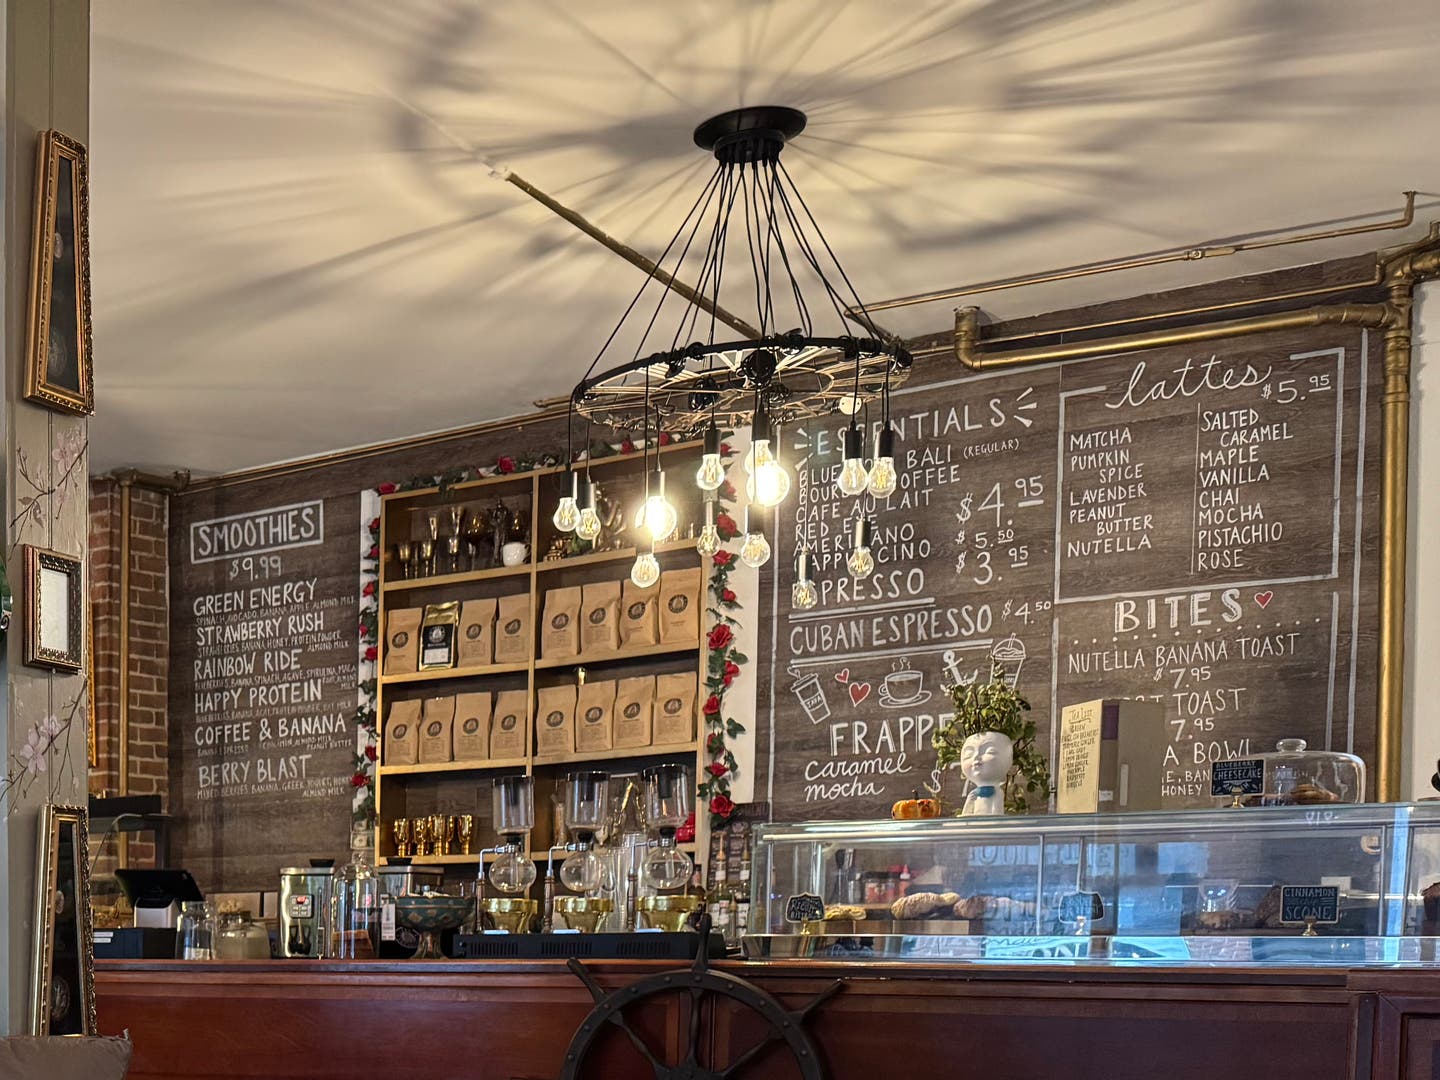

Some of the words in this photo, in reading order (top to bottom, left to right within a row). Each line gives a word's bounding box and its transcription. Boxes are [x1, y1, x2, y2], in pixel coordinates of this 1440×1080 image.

[1105, 355, 1272, 408] lattes
[1200, 408, 1259, 432] SALTED
[1070, 427, 1132, 451] MATCHA
[1220, 422, 1293, 448] CARAMEL
[906, 446, 951, 470] BALI
[963, 438, 1021, 460] (REGULAR)
[1071, 449, 1130, 471] PUMPKIN
[1199, 445, 1259, 469] MAPLE
[901, 464, 961, 490] OFFEE
[1099, 463, 1145, 483] SPICE
[1199, 464, 1270, 488] VANILLA
[796, 500, 840, 524] CAFE
[851, 499, 877, 517] AU
[886, 488, 934, 512] LAIT
[1070, 482, 1147, 507] LAVENDER
[1199, 487, 1240, 509] CHAI
[1069, 502, 1127, 524] PEANUT
[1096, 514, 1154, 536] BUTTER
[1198, 503, 1264, 527] MOCHA
[198, 507, 315, 556] SMOOTHIES
[793, 523, 915, 557] AMERIANO
[795, 521, 829, 542] RED
[843, 513, 879, 534] EE
[1198, 522, 1283, 549] PISTACHIO
[1067, 534, 1152, 558] NUTELLA
[229, 555, 282, 582] $9.99
[1198, 549, 1244, 571] ROSE
[193, 589, 244, 617] GREEN
[250, 577, 317, 609] ENERGY
[1001, 599, 1052, 625] $4.50
[1114, 588, 1243, 633] BITES
[196, 616, 282, 647] STRAWBERRY
[288, 610, 324, 636] RUSH
[790, 620, 864, 655] CUBAN
[872, 604, 993, 647] ESPRESSO
[333, 640, 350, 649] MILK
[1068, 648, 1145, 674] NUTELLA
[1155, 641, 1229, 668] BANANA
[1236, 633, 1301, 659] TOAST
[194, 651, 256, 682] RAINBOW
[264, 649, 303, 673] RIDE
[1153, 665, 1211, 690] $7.95
[195, 687, 242, 714] HAPPY
[249, 678, 322, 708] PROTEIN
[1172, 688, 1247, 716] TOAST
[194, 721, 253, 746] COFFEE
[259, 718, 272, 742] &
[278, 712, 347, 738] BANANA
[1170, 717, 1215, 742] 7.95
[198, 760, 250, 789] BERRY
[257, 754, 312, 783] BLAST
[805, 752, 913, 781] caramel
[1213, 768, 1262, 781] CHEESECAKE
[327, 786, 345, 797] MILK
[804, 776, 885, 802] mocha
[1161, 783, 1203, 797] HONEY
[1284, 887, 1335, 897] CINNAMON
[1284, 905, 1332, 921] SCONE
